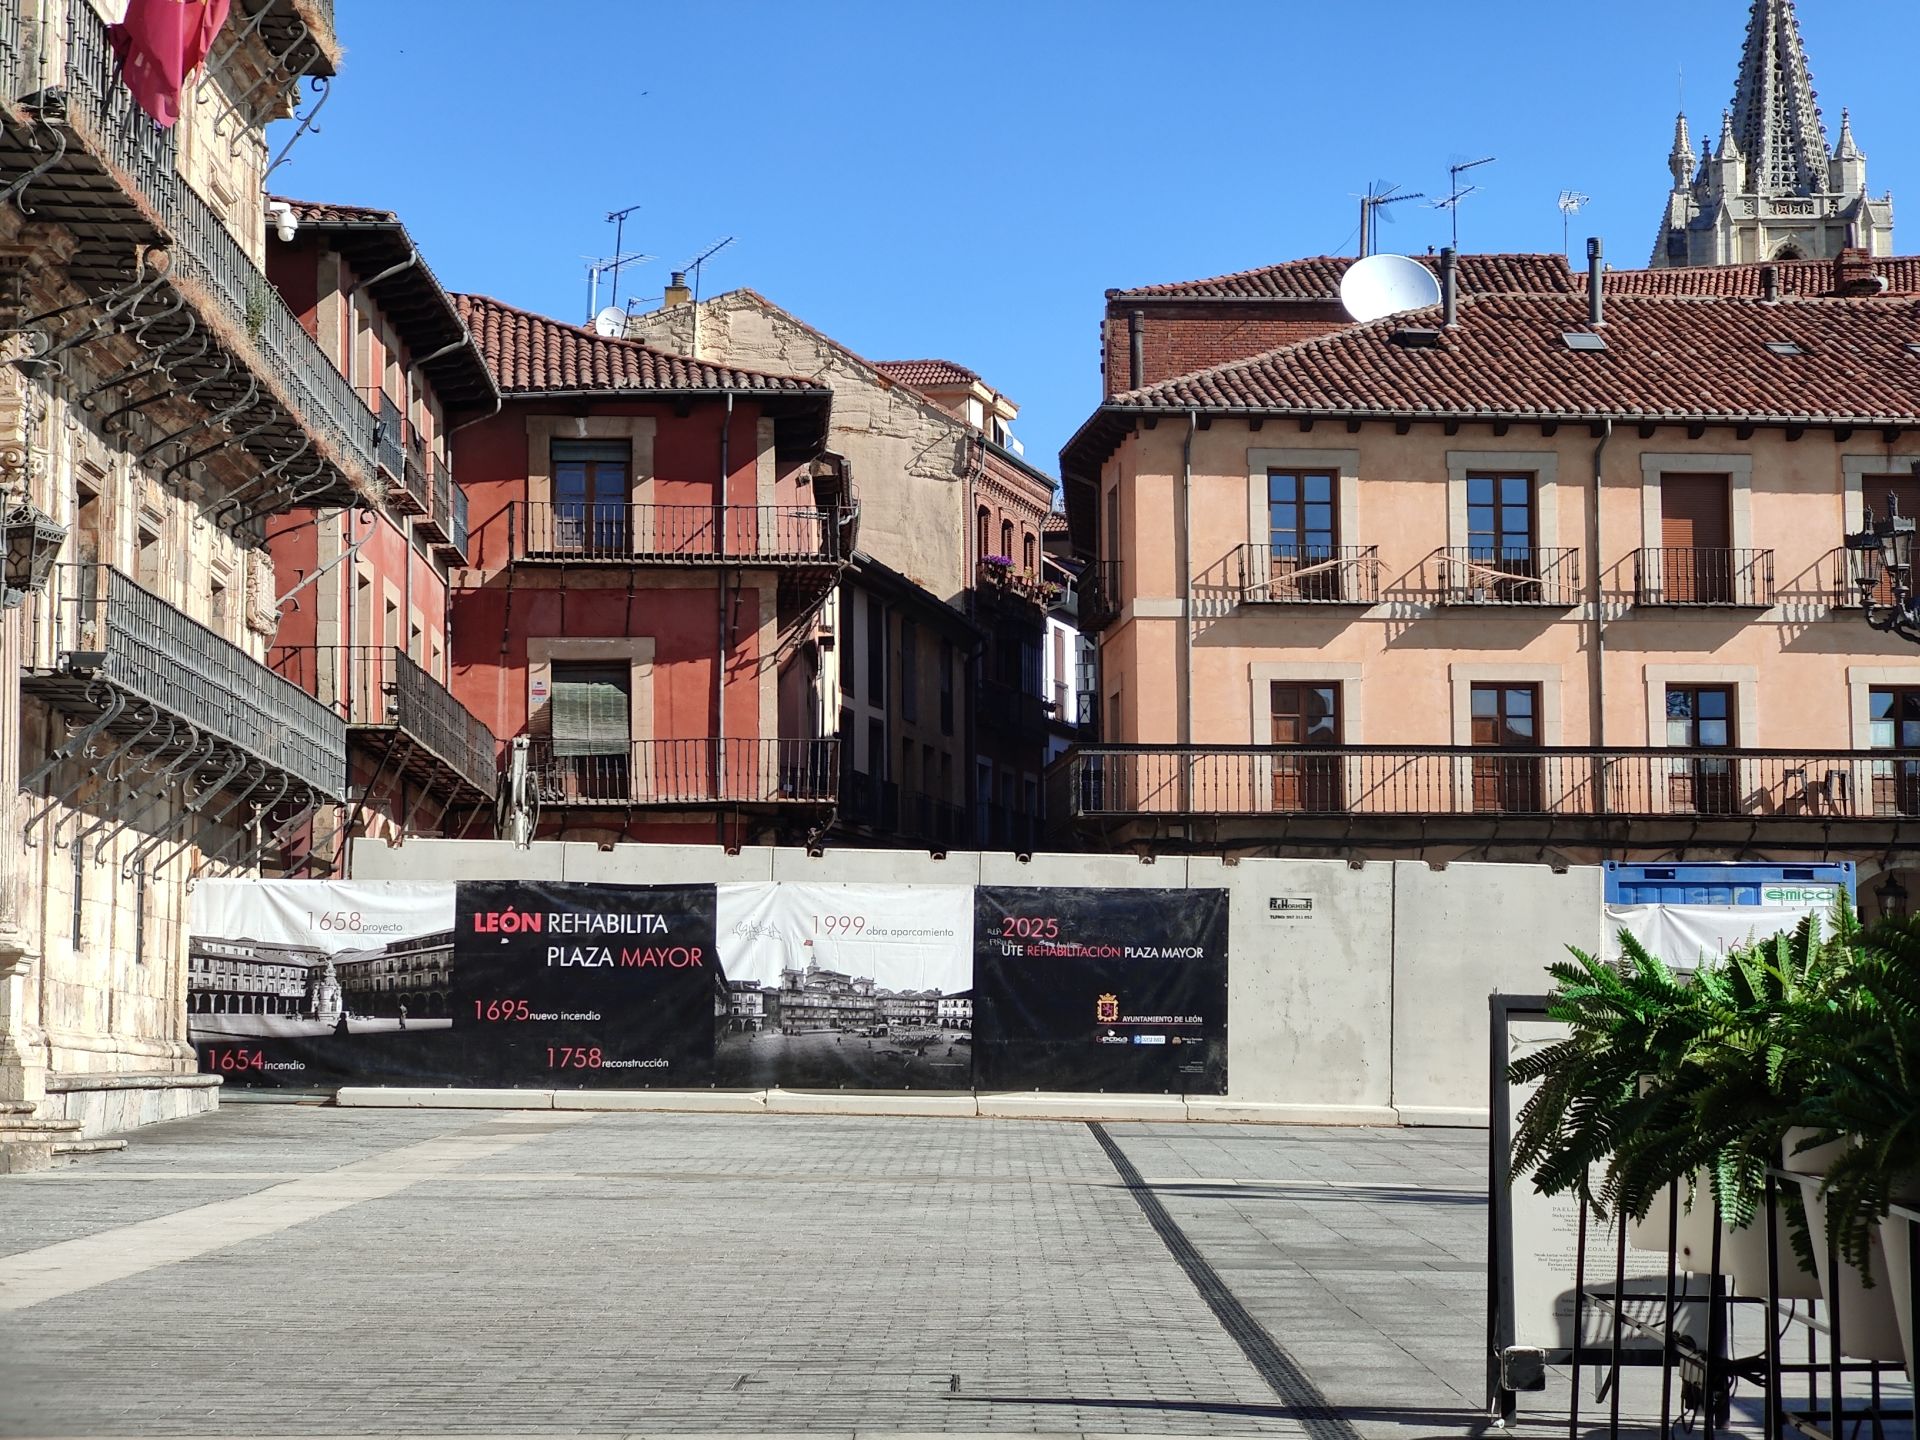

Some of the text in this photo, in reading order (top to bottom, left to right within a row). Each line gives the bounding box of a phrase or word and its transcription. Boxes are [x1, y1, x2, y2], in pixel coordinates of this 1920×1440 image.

[1765, 889, 1835, 900] emico
[307, 911, 403, 933] 1658 proyecto
[474, 905, 668, 934] LEÓN REHABILITA
[812, 915, 954, 940] 1999 obra aparcamiento
[1002, 917, 1058, 938] 2025
[547, 947, 703, 968] PLAZA MAYOR
[1001, 945, 1024, 957] UTE
[1027, 944, 1121, 958] REHABILITACIÓN
[1124, 947, 1159, 958] PLAZA
[1161, 947, 1204, 958] MAYOR
[475, 1000, 601, 1021] 1695 nuevo incendio
[1185, 1014, 1203, 1023] LEÓN
[208, 1050, 306, 1070] 1654 incendio
[547, 1048, 669, 1068] 1758 reconstrucción
